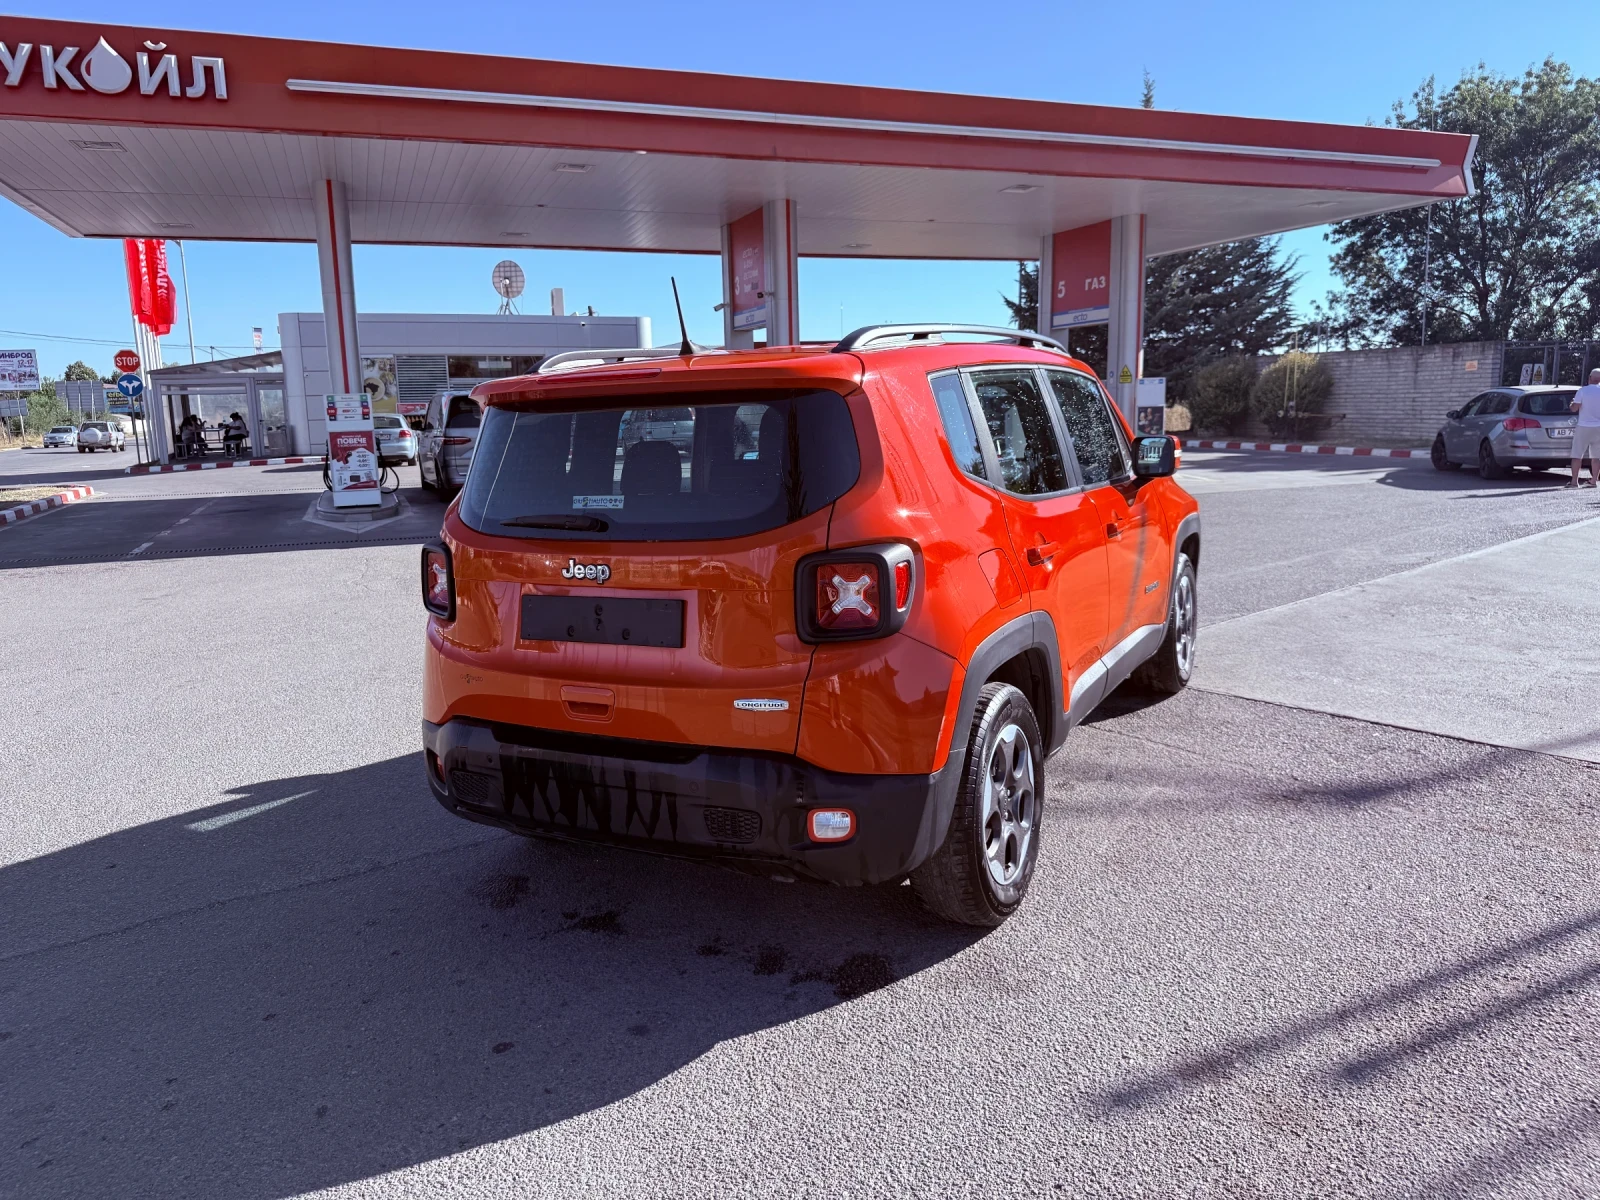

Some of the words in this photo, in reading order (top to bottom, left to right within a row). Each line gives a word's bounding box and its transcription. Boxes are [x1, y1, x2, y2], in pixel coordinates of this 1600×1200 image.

[735, 276, 740, 295] 3
[1057, 280, 1066, 299] 5
[1085, 276, 1106, 291] ГАЗ
[1073, 313, 1088, 322] ecto
[116, 357, 139, 366] STOP
[561, 558, 610, 584] Jeep
